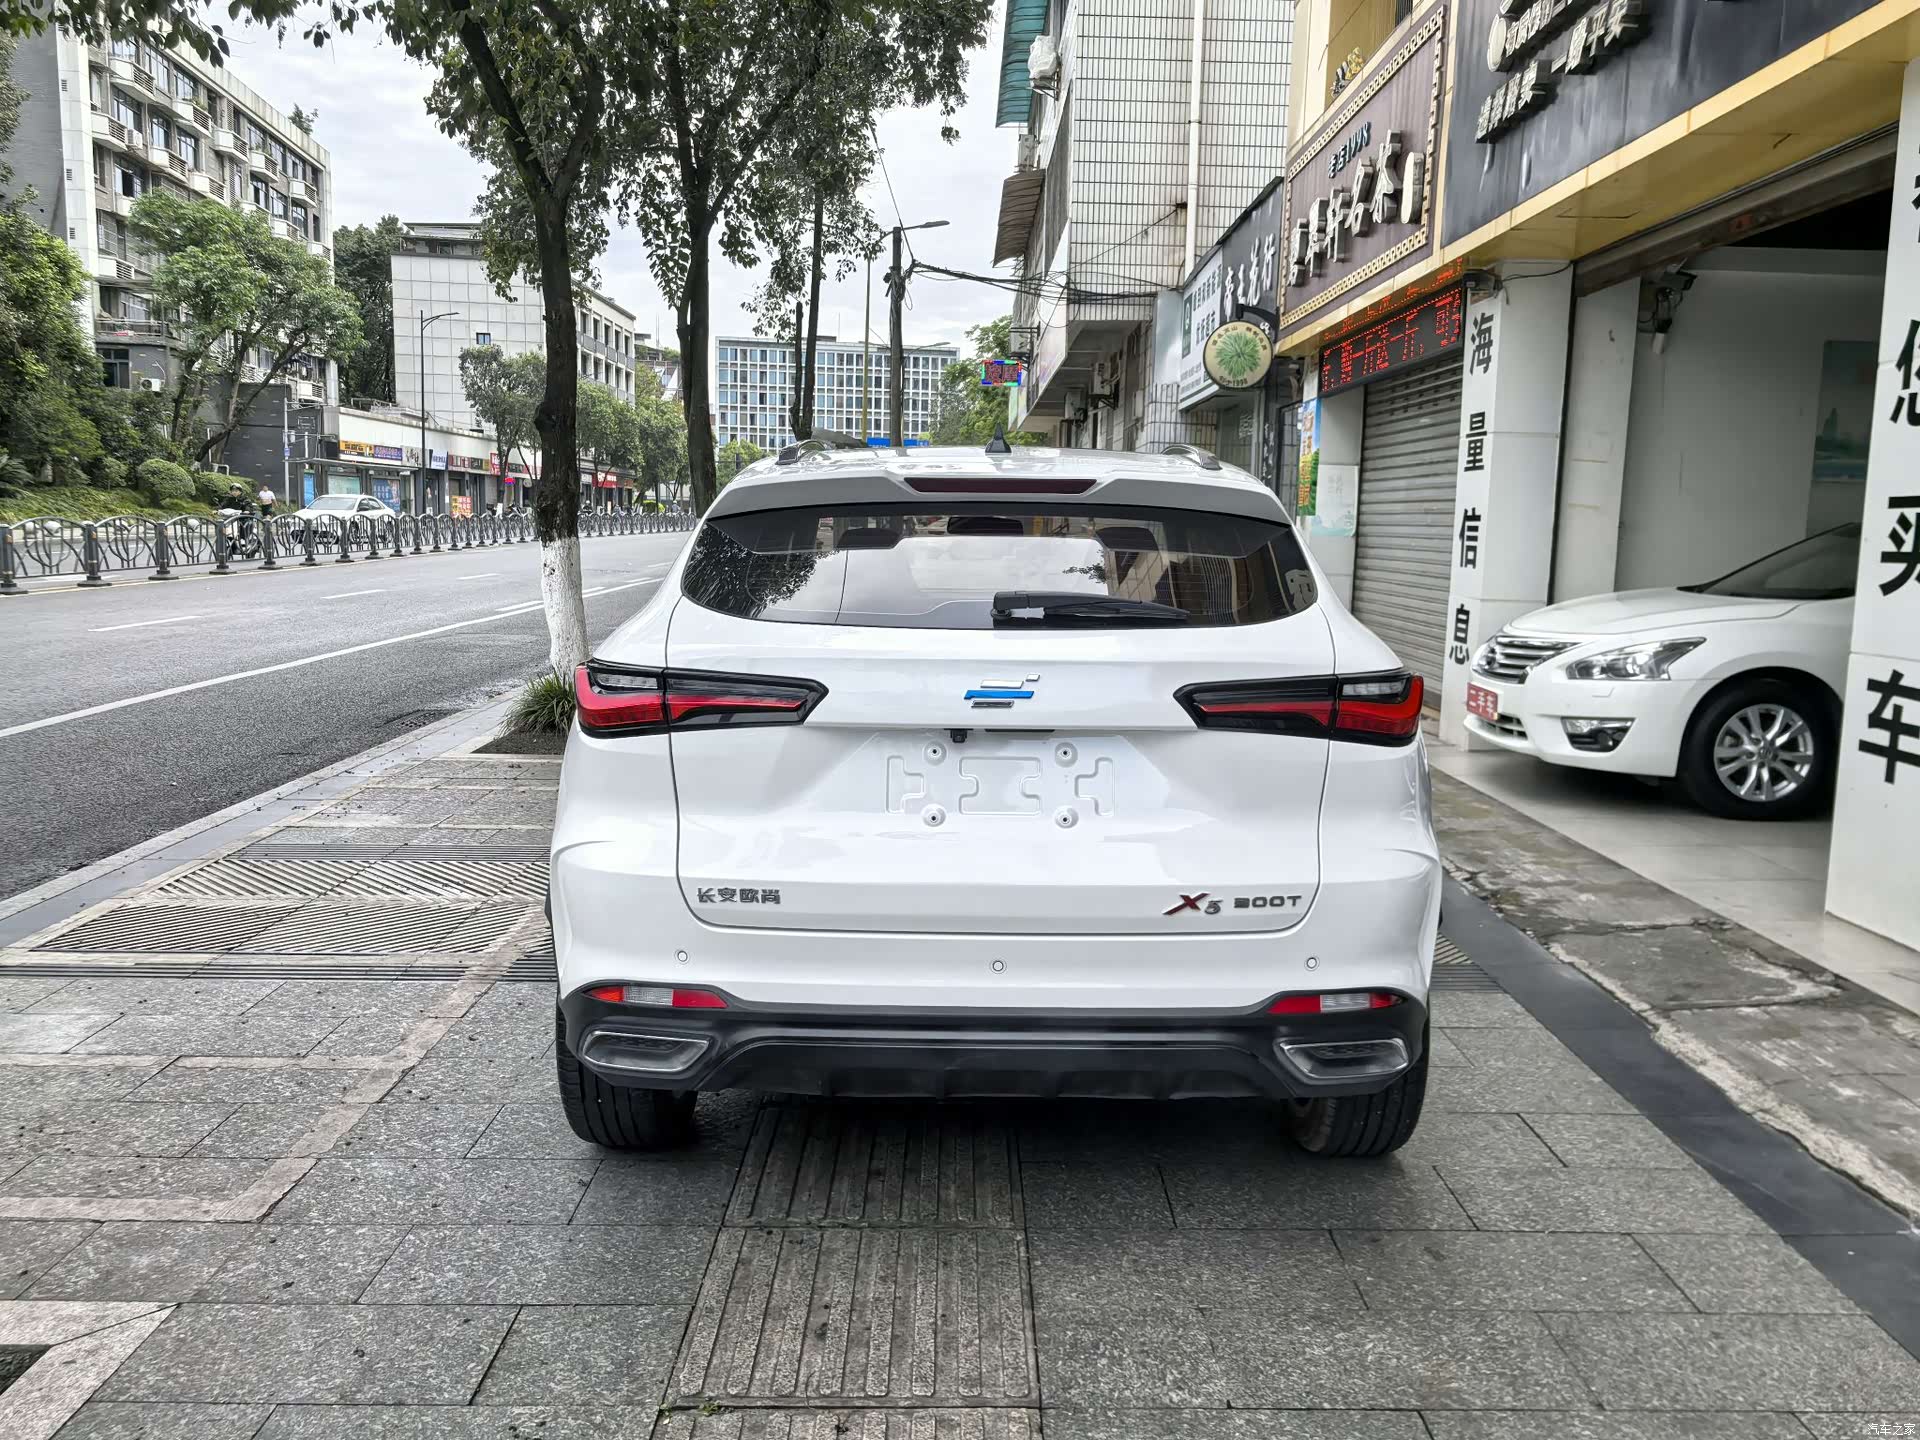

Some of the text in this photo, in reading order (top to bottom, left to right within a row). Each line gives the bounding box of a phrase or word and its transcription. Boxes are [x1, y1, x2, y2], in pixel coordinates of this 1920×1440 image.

[1449, 312, 1494, 665] 海量信息
[697, 887, 781, 904] 长安欧尚
[1162, 892, 1302, 915] X5 300T
